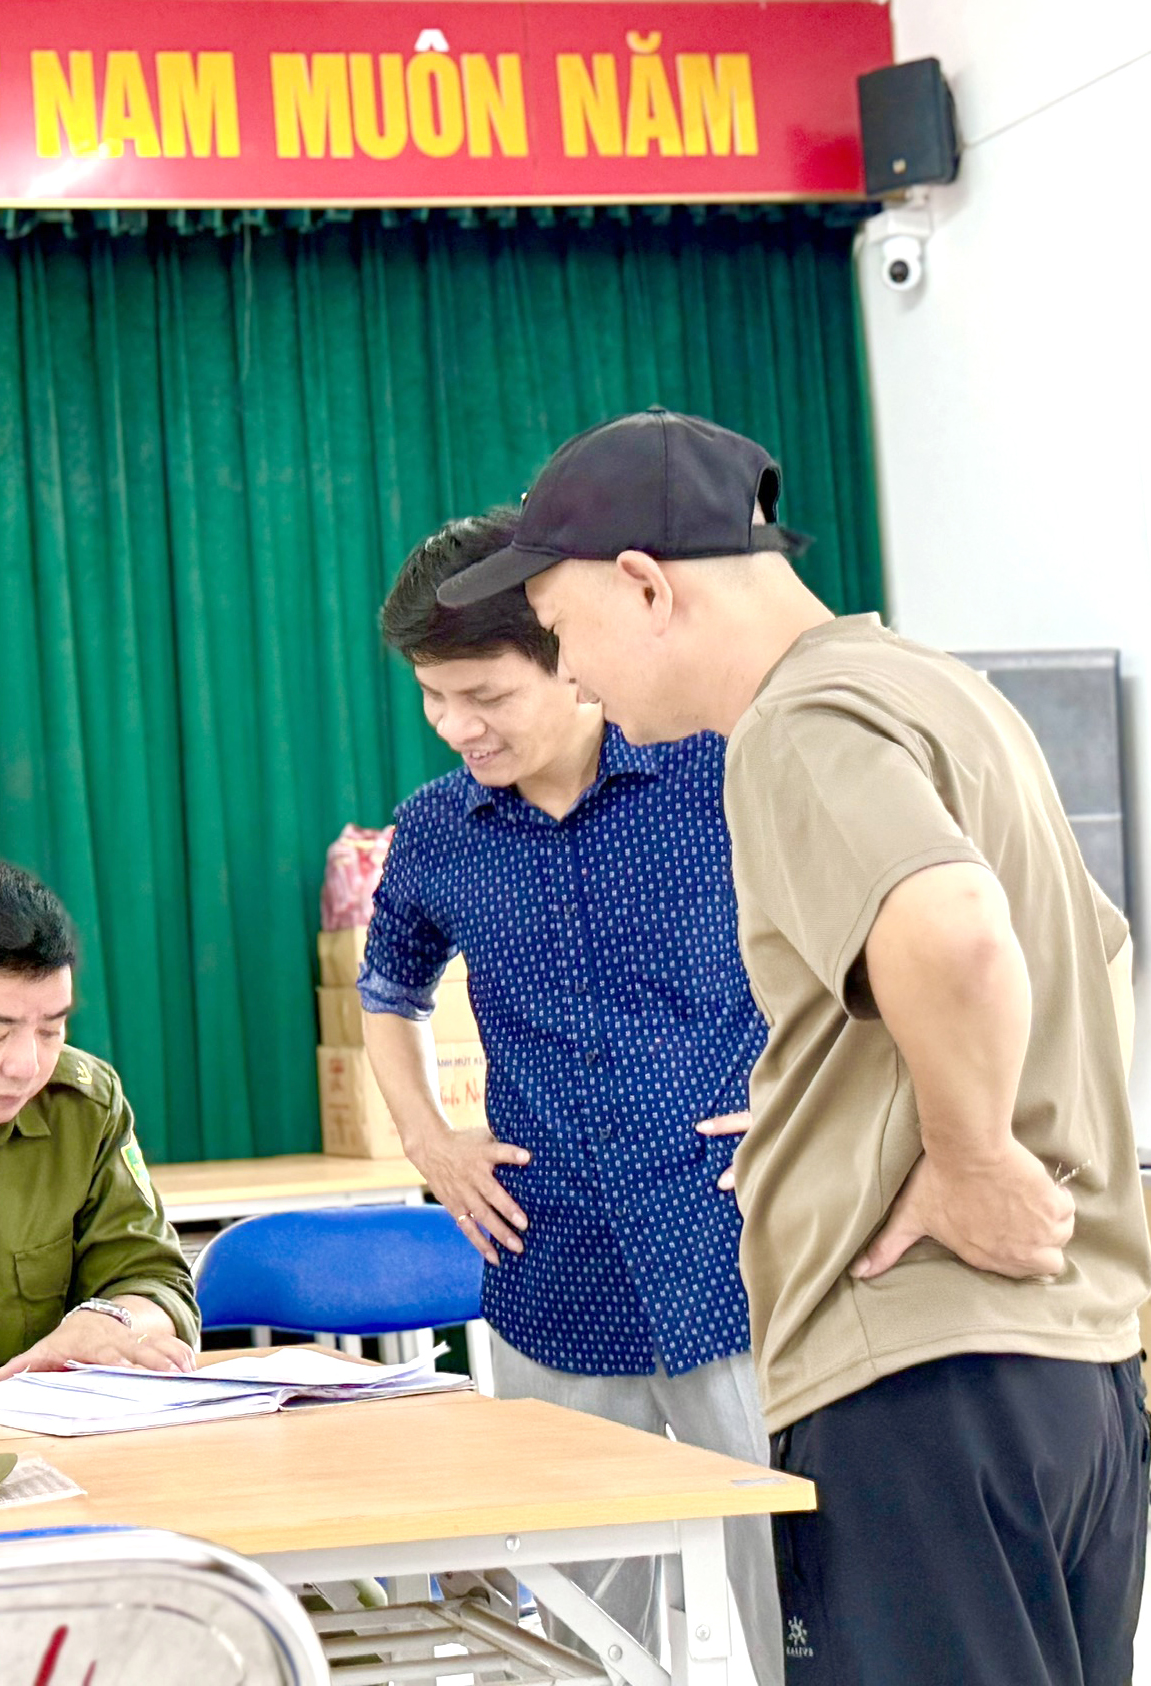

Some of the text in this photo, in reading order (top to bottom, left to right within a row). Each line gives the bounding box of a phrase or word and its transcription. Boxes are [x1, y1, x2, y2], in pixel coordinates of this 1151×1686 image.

[31, 51, 241, 158] NAM
[270, 28, 529, 160] MUÔN
[557, 32, 758, 157] NĂM
